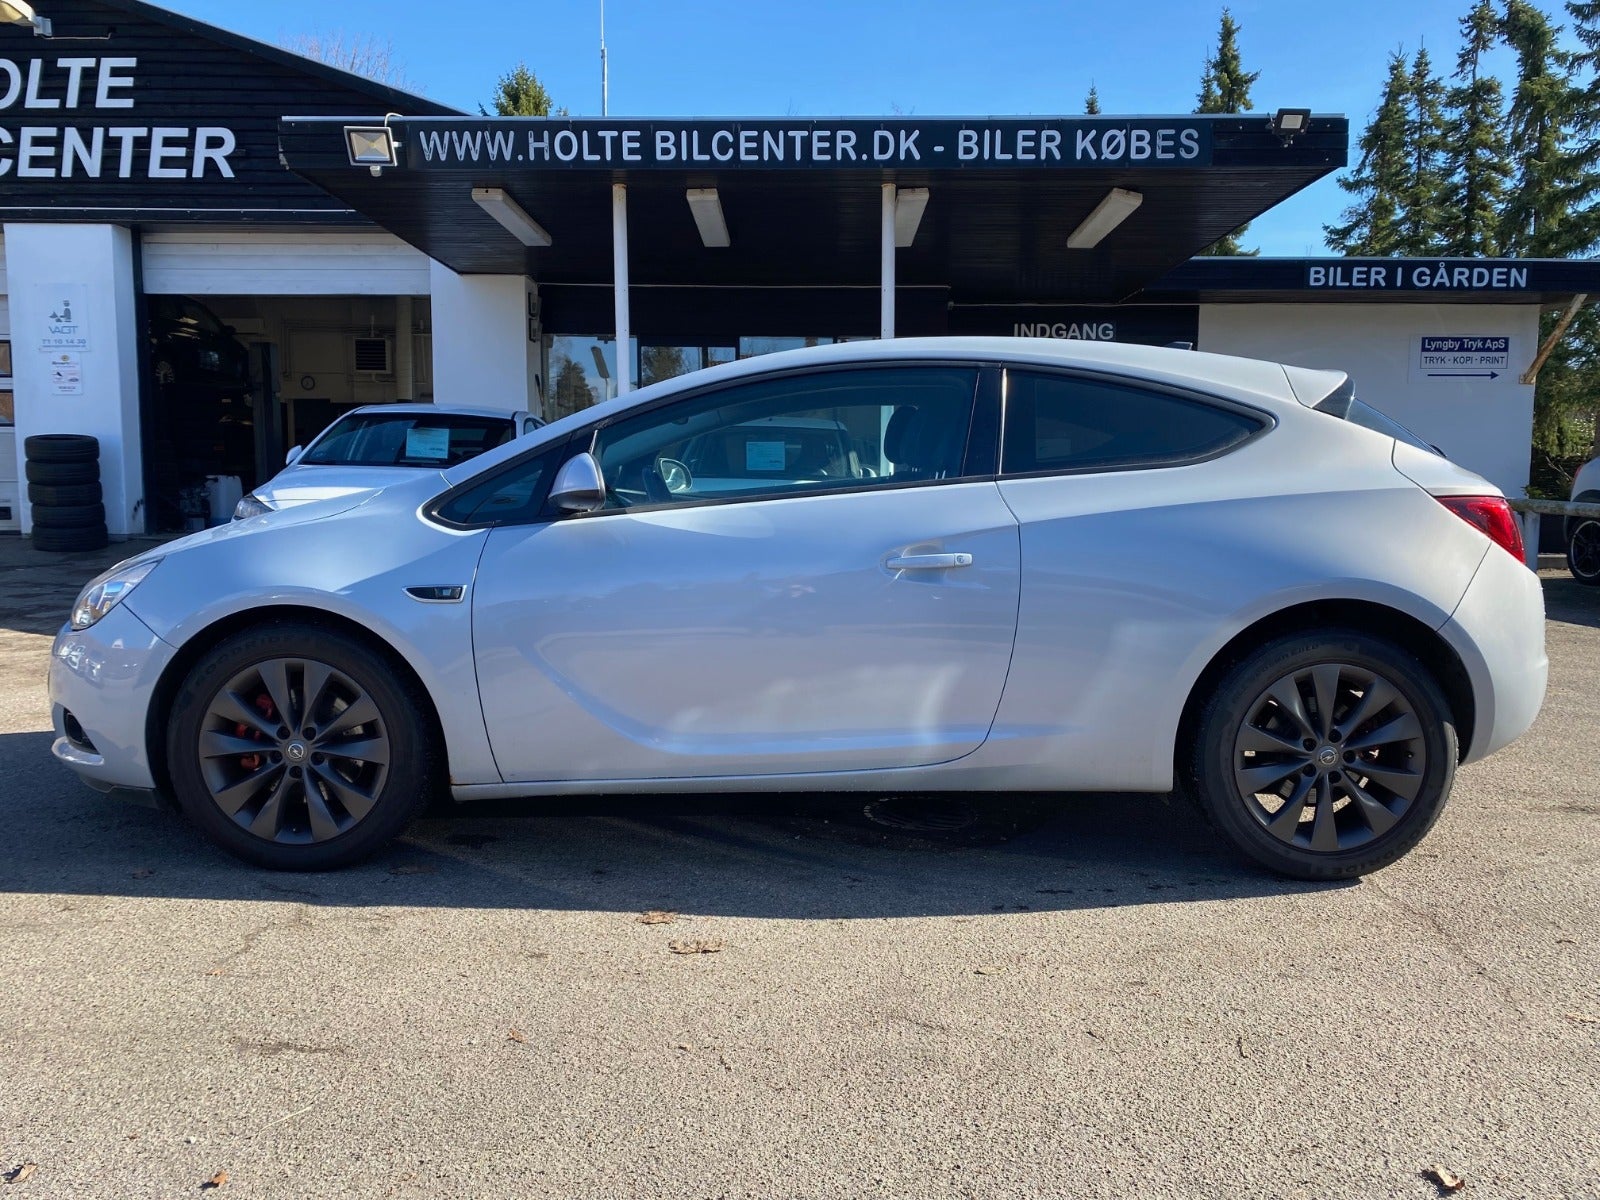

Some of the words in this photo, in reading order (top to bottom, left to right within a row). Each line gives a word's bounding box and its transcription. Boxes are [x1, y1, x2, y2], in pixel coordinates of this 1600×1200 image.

[419, 130, 642, 162] WWW.HOLTE
[655, 130, 921, 161] BILCENTER.DK
[958, 129, 1062, 161] BILER
[1076, 128, 1200, 160] KØBES
[1308, 266, 1387, 287] BILER
[1396, 266, 1403, 287] I
[1412, 262, 1528, 288] GÅRDEN
[1013, 323, 1114, 340] INDGANG
[1424, 339, 1461, 351] Lyngby
[1462, 339, 1484, 351] Tryk
[1484, 339, 1506, 351] ApS
[1423, 356, 1447, 365] TRYK
[1453, 356, 1474, 365] KOPI
[1480, 356, 1506, 365] PRINT
